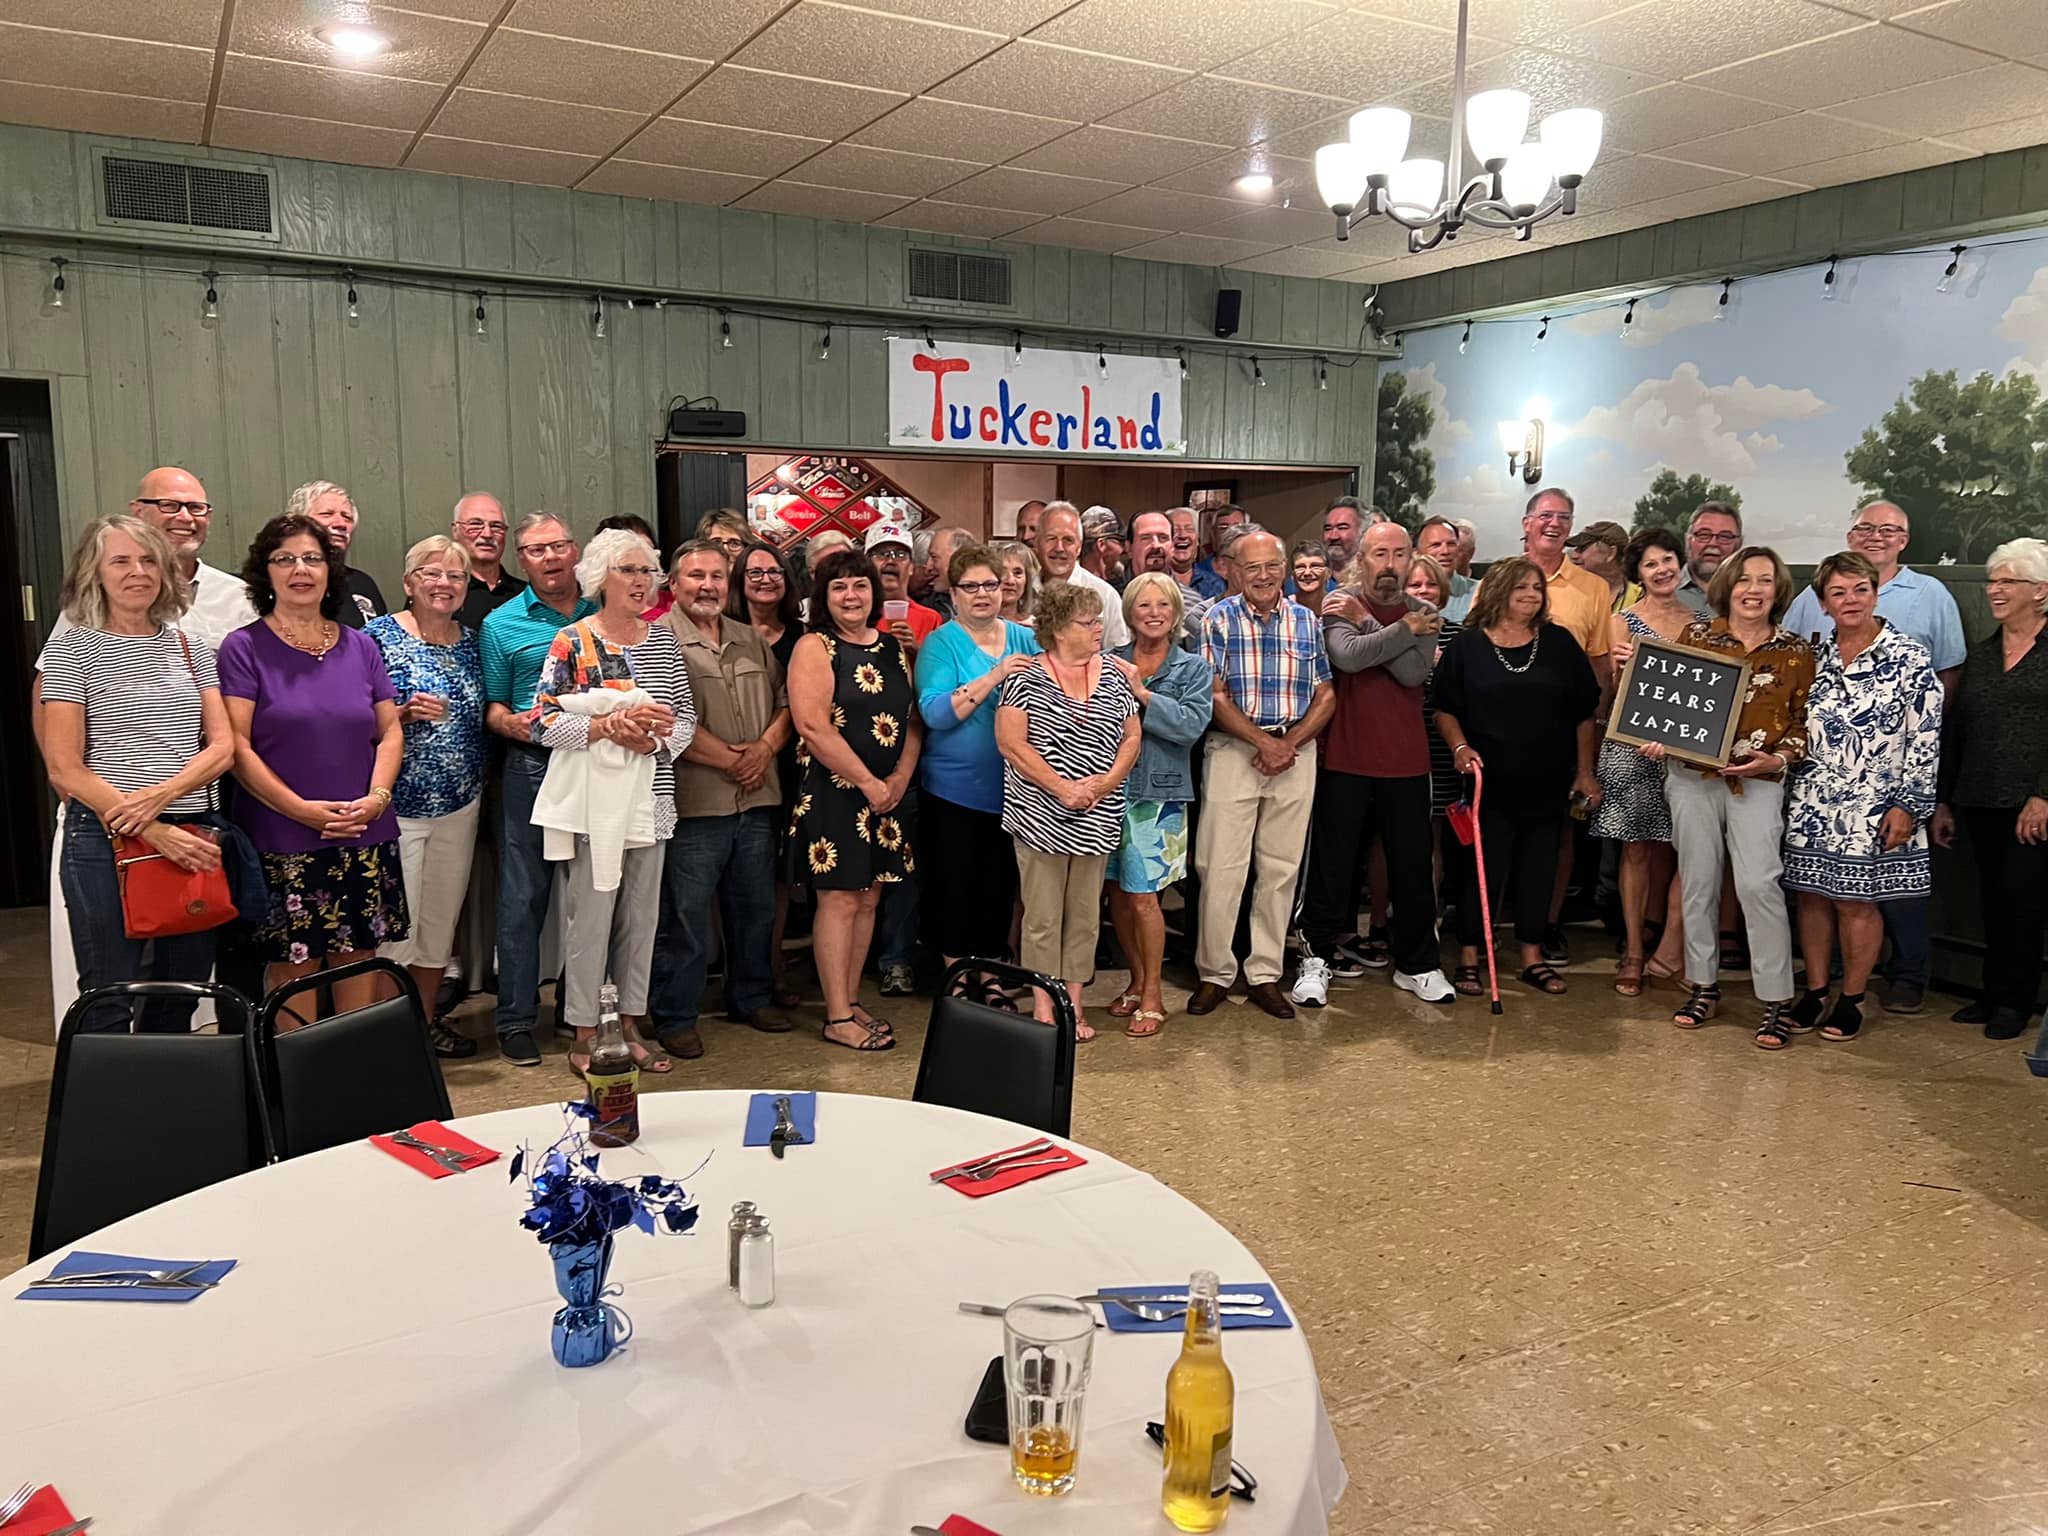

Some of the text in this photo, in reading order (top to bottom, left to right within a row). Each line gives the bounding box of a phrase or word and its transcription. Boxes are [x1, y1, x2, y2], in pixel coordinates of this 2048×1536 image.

[912, 353, 1163, 450] Tuckerland
[1642, 655, 1722, 687] FIFTY
[1638, 682, 1716, 713] YEARS
[1629, 711, 1709, 743] LATER
